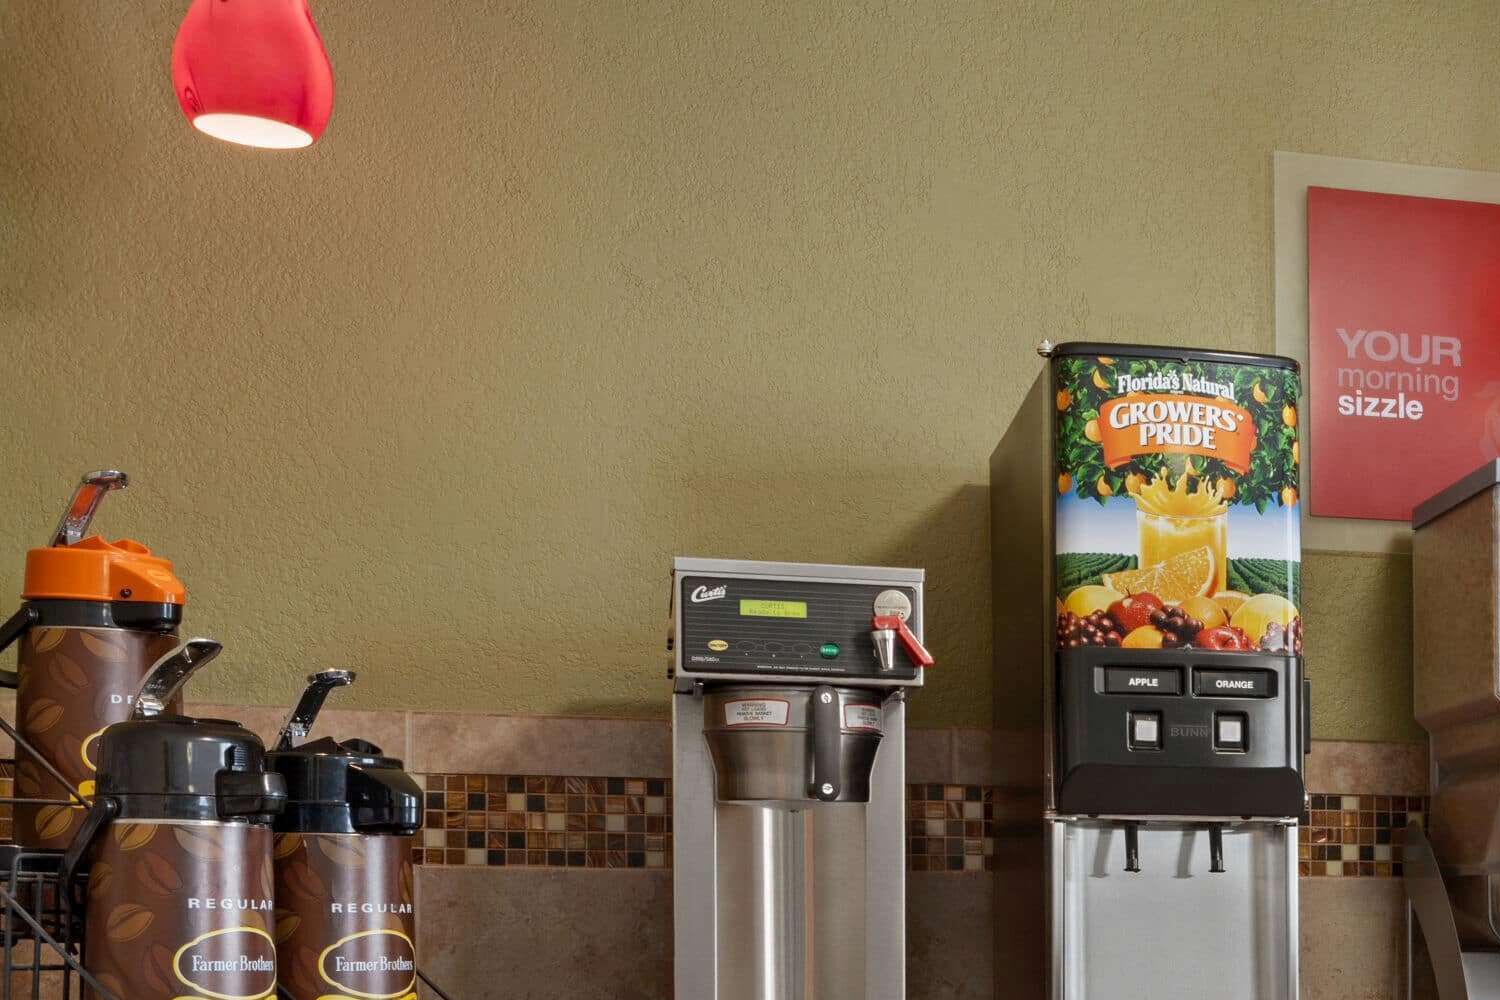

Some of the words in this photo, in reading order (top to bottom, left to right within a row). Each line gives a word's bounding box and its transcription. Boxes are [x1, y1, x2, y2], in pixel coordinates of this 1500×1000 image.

[1336, 328, 1462, 367] YOUR
[1117, 369, 1180, 394] Florida's
[1182, 373, 1234, 400] Natural
[1338, 367, 1459, 401] morning
[1338, 389, 1424, 420] sizzle
[1140, 423, 1217, 450] PRIDE
[1128, 677, 1159, 687] APPLE
[1215, 679, 1254, 689] ORANGE
[1170, 726, 1209, 738] BUNN
[188, 897, 273, 910] REGULAR
[331, 903, 412, 914] REGULAR
[192, 954, 238, 972] Farmer
[239, 954, 274, 971] Brothers
[336, 956, 379, 972] Farmer
[379, 956, 413, 971] Brothers
